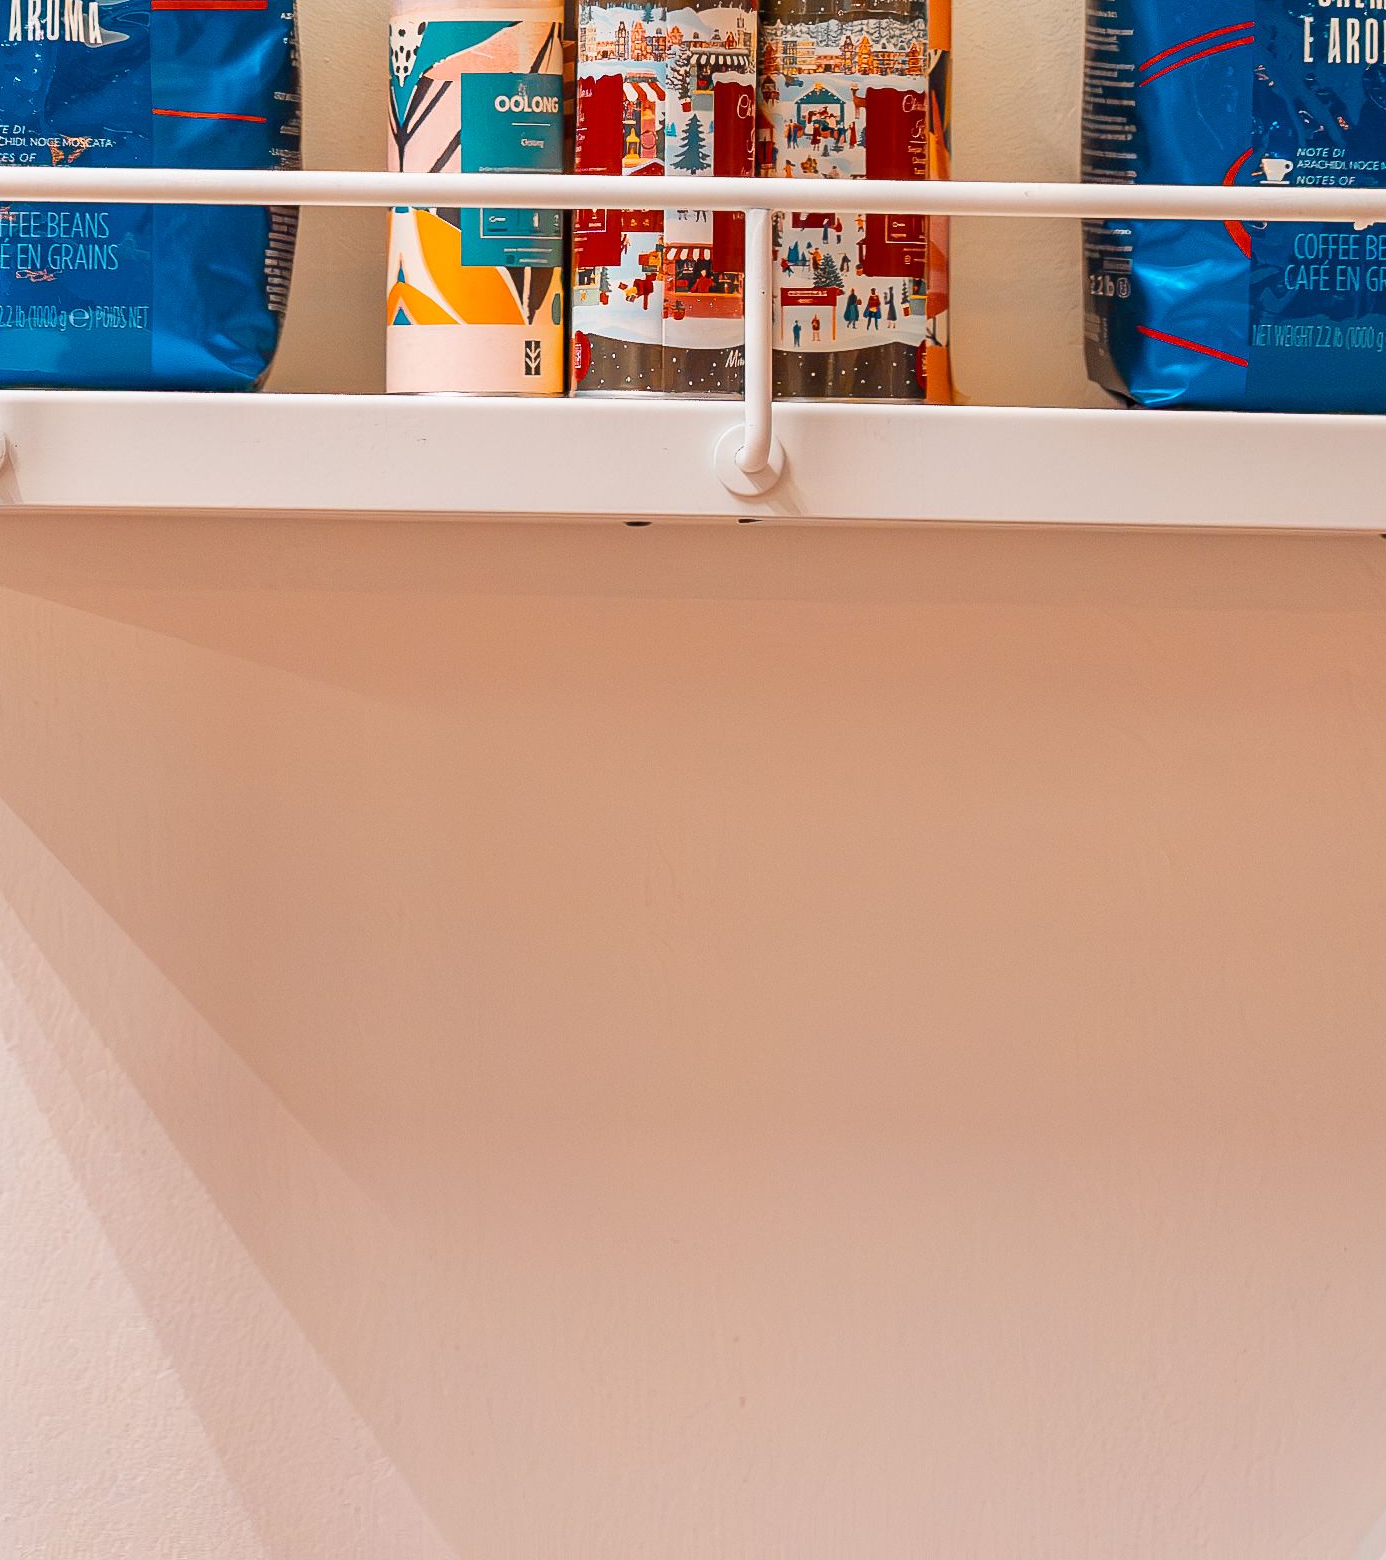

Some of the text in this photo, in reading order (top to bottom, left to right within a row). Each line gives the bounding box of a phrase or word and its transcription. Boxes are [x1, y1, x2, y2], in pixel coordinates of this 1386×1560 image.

[1303, 16, 1314, 63] E
[494, 94, 559, 114] OOLONG
[13, 124, 26, 135] DI
[19, 152, 37, 163] OF
[1296, 147, 1346, 158] NOTE DI
[1296, 175, 1356, 186] NOTES OF
[46, 211, 110, 239] BEANS
[16, 243, 42, 270] EN
[47, 243, 119, 271] GRAINS
[1293, 233, 1361, 260] COFFEE
[1284, 259, 1331, 292] CAFÉ
[1335, 265, 1360, 292] EN
[128, 305, 150, 329] NET
